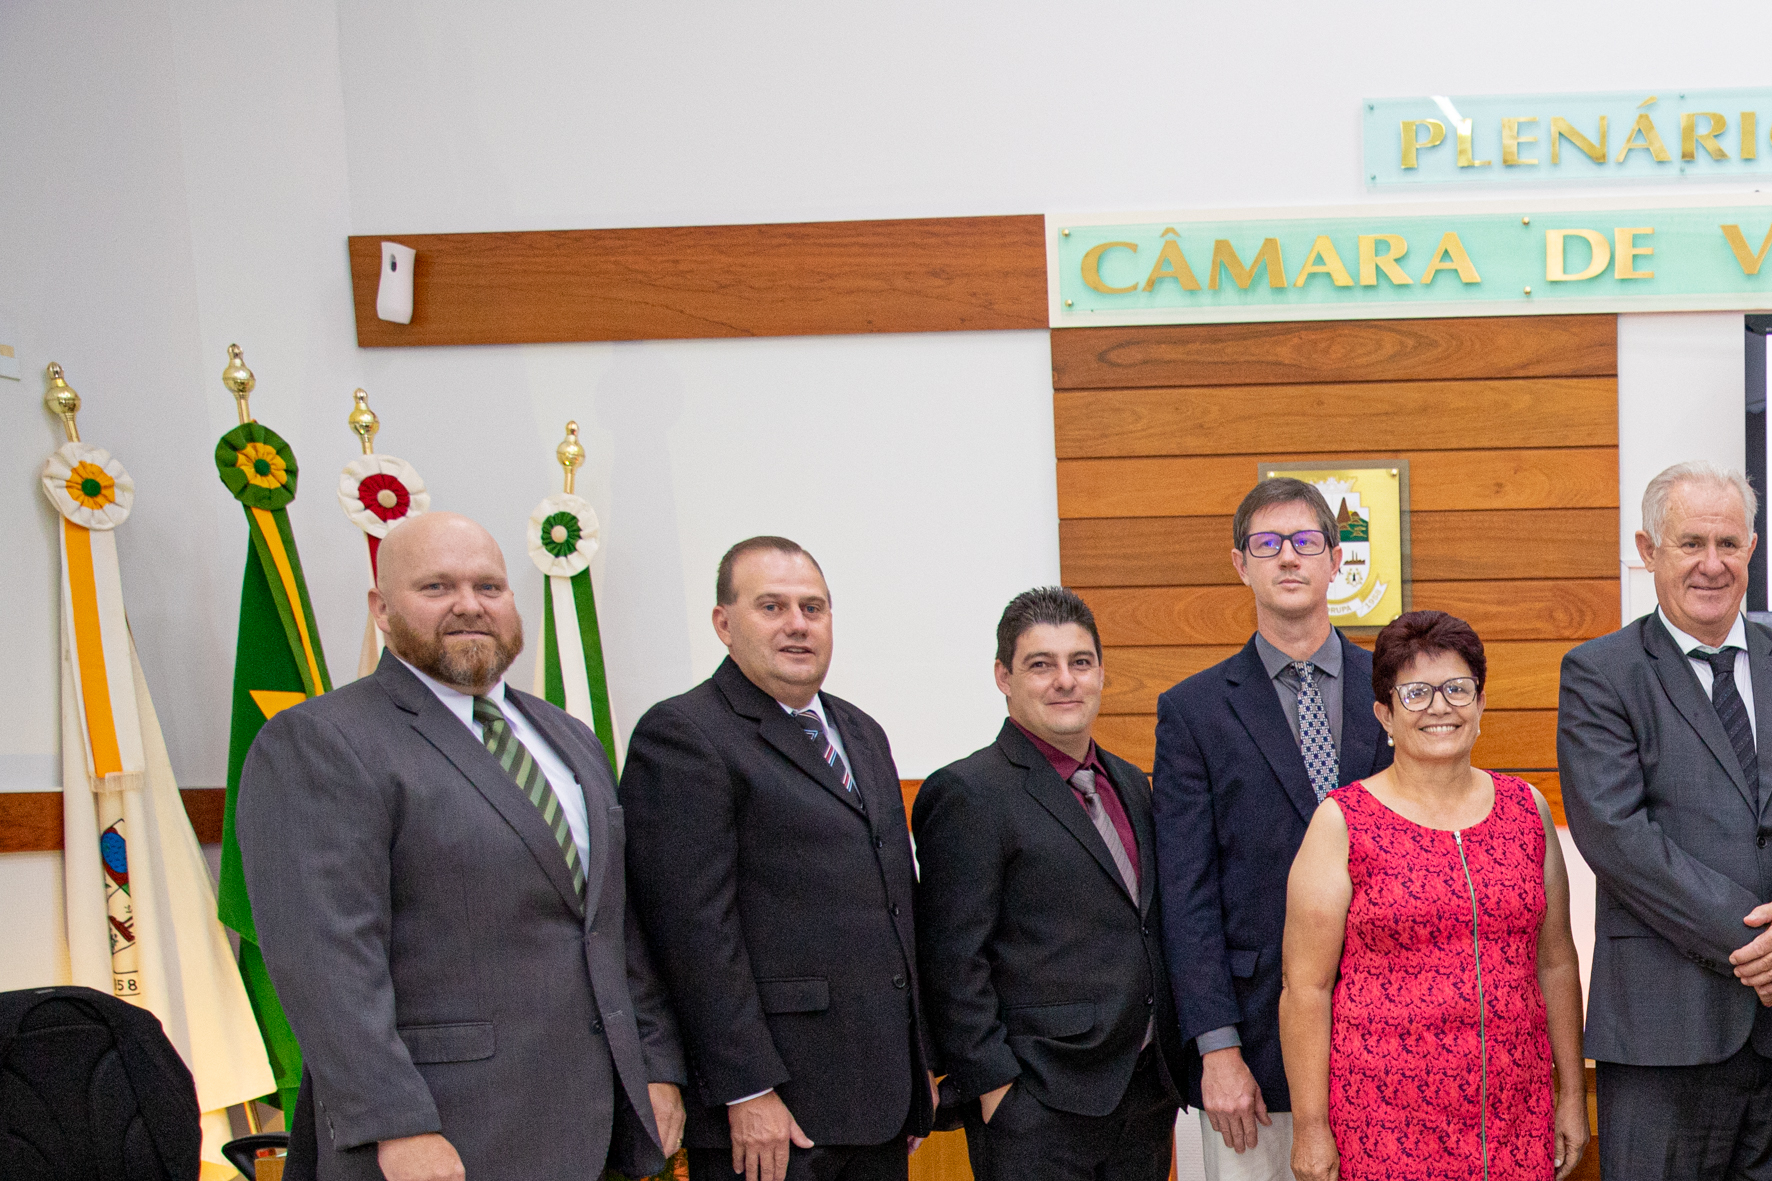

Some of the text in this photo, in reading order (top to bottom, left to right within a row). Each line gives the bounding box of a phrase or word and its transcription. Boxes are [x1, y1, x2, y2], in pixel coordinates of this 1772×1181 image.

[1080, 227, 1482, 294] CÂMARA
[1545, 227, 1655, 282] DE
[115, 978, 138, 992] 58
